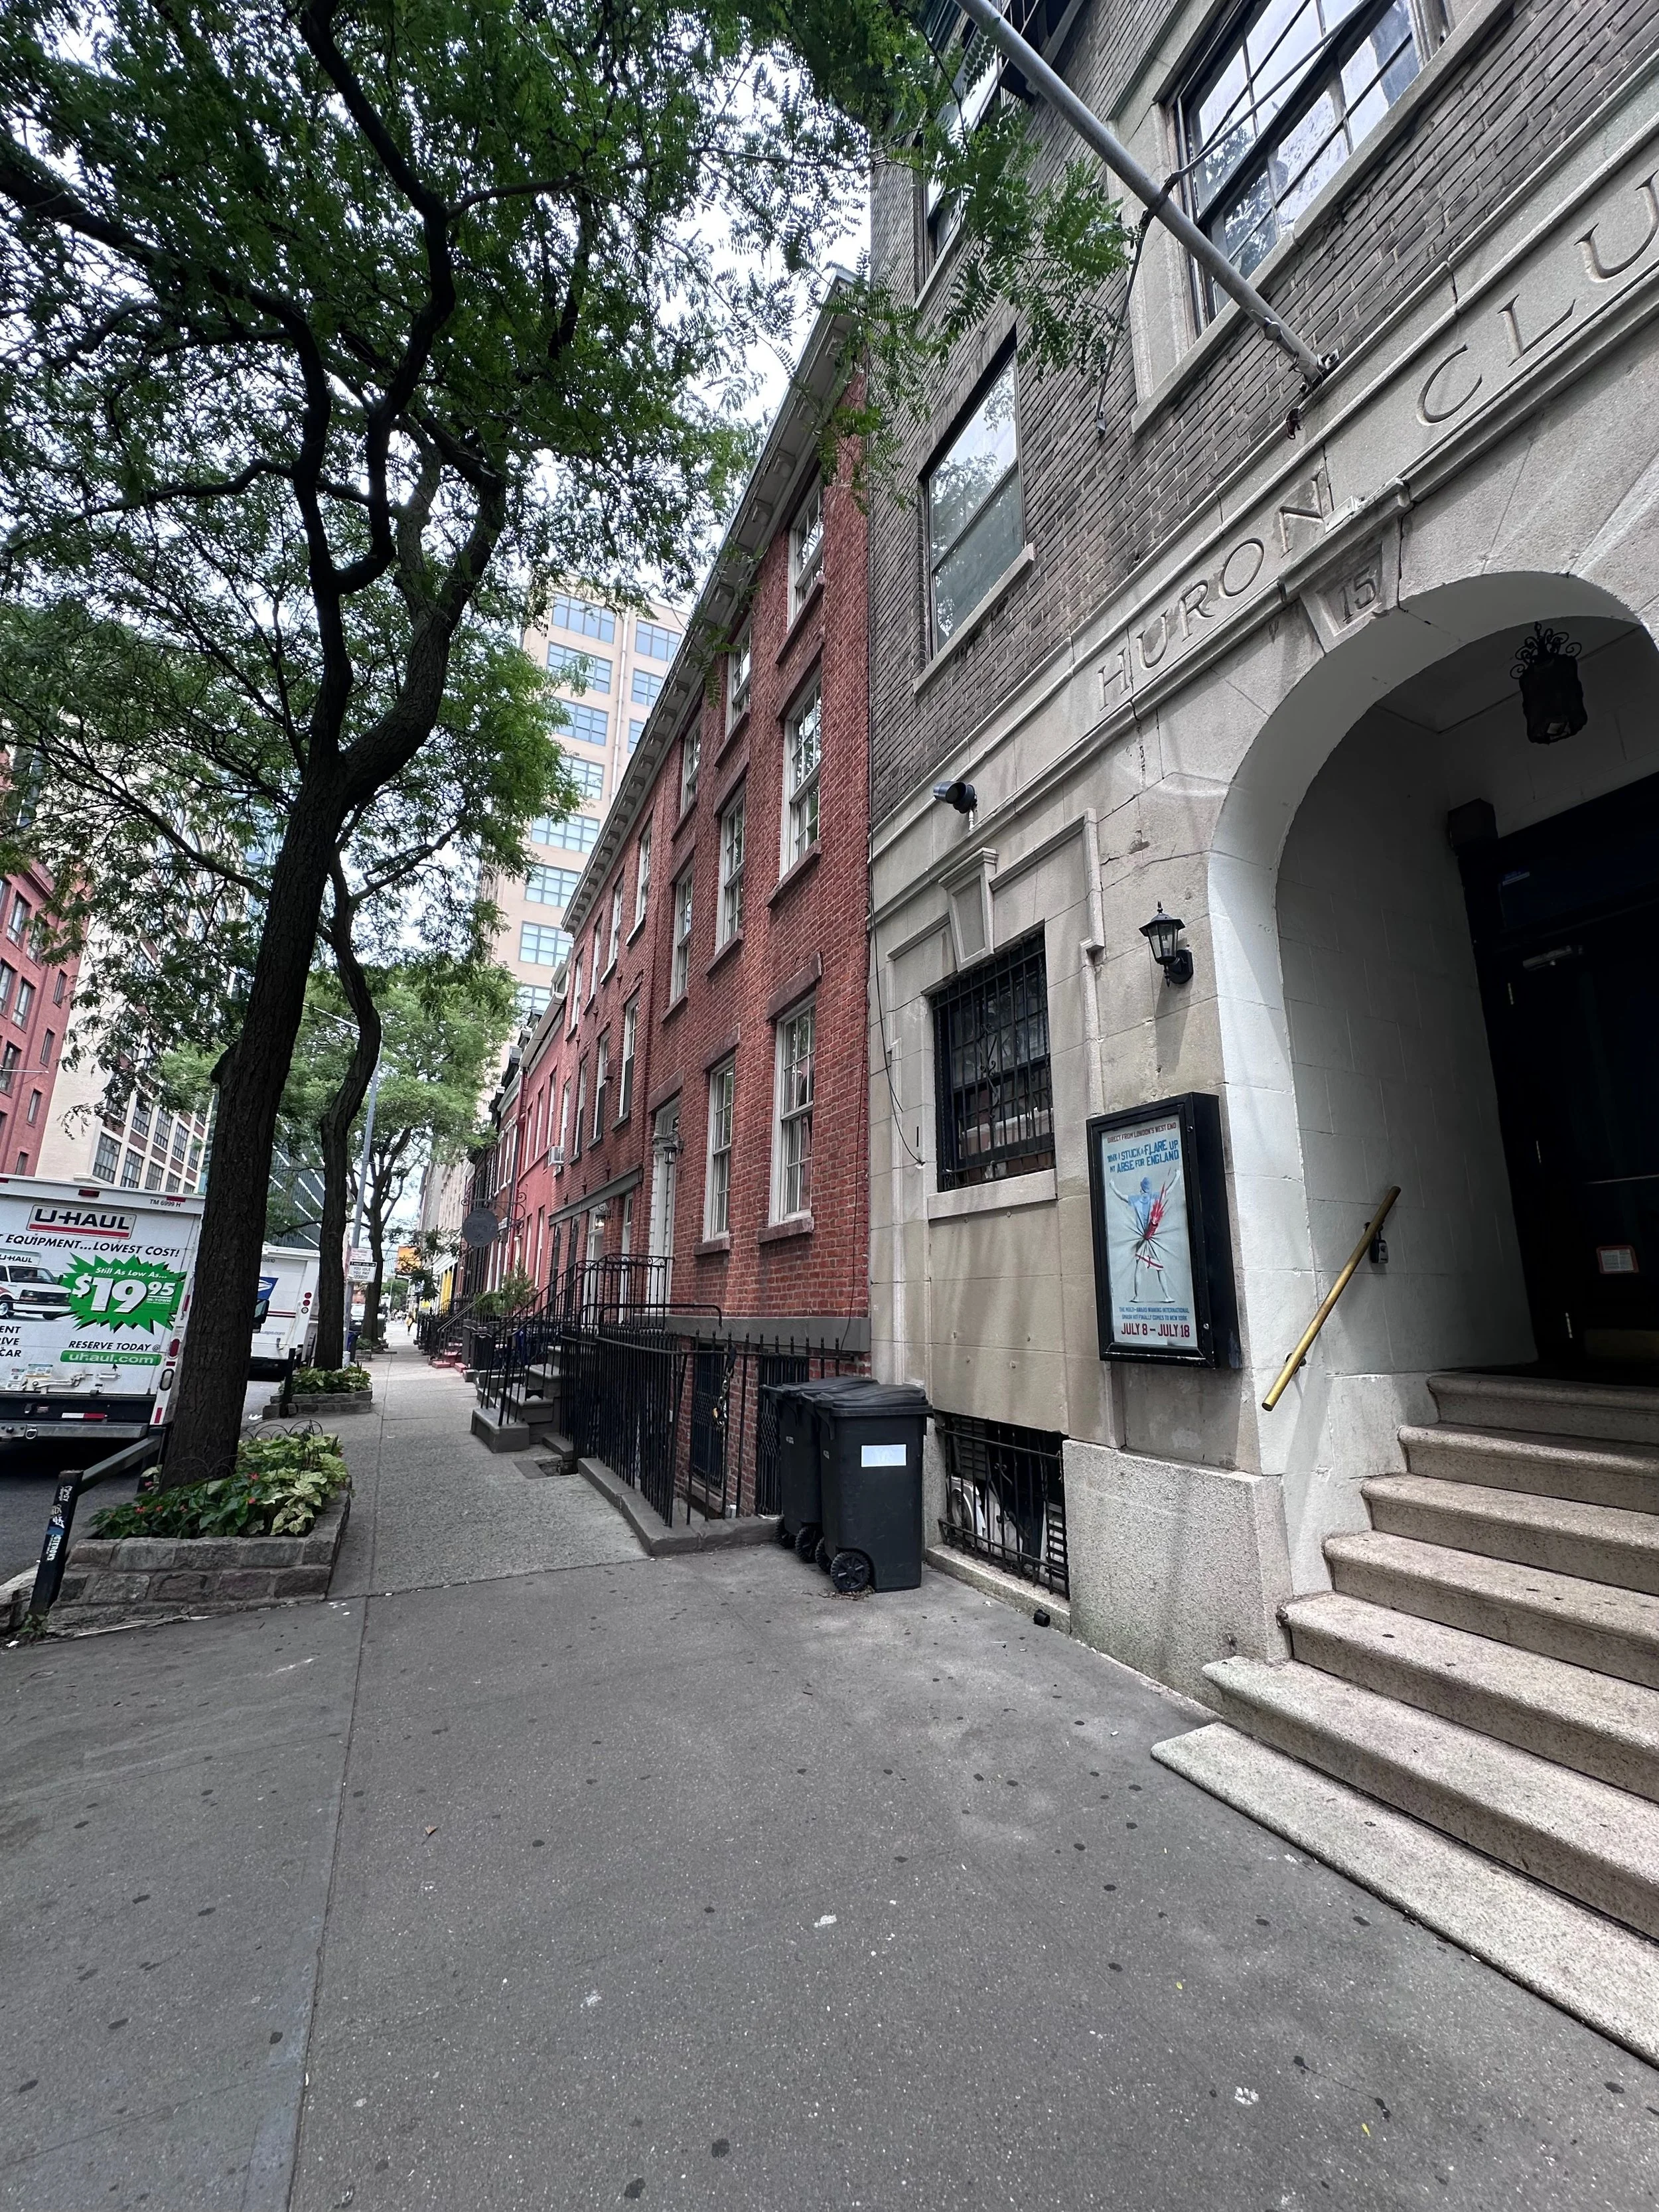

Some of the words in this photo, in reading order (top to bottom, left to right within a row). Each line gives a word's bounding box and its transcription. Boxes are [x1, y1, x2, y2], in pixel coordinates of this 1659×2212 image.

[1098, 467, 1325, 711] HURON
[1416, 170, 1659, 425] CLU
[1338, 566, 1376, 622] 15
[1108, 1134, 1121, 1143] DIRECT
[1134, 1127, 1155, 1138] LONDON'S
[1155, 1124, 1166, 1133] WEST
[1121, 1147, 1141, 1160] STUCK
[1144, 1140, 1167, 1155] FLARE
[1169, 1140, 1179, 1150] UP
[1117, 1160, 1135, 1173] ARSE
[1135, 1158, 1145, 1167] FOR
[1146, 1149, 1179, 1166] ENGLAND
[35, 1209, 129, 1230] U-HAUL
[145, 1246, 180, 1258] COST!
[1121, 1323, 1140, 1335] JULY
[1142, 1323, 1148, 1335] 8
[1158, 1324, 1178, 1337] JULY
[1181, 1325, 1190, 1337] 18
[68, 1341, 113, 1349] RESERVE
[116, 1342, 151, 1351] TODAY
[69, 1353, 154, 1364] uhaul.com
